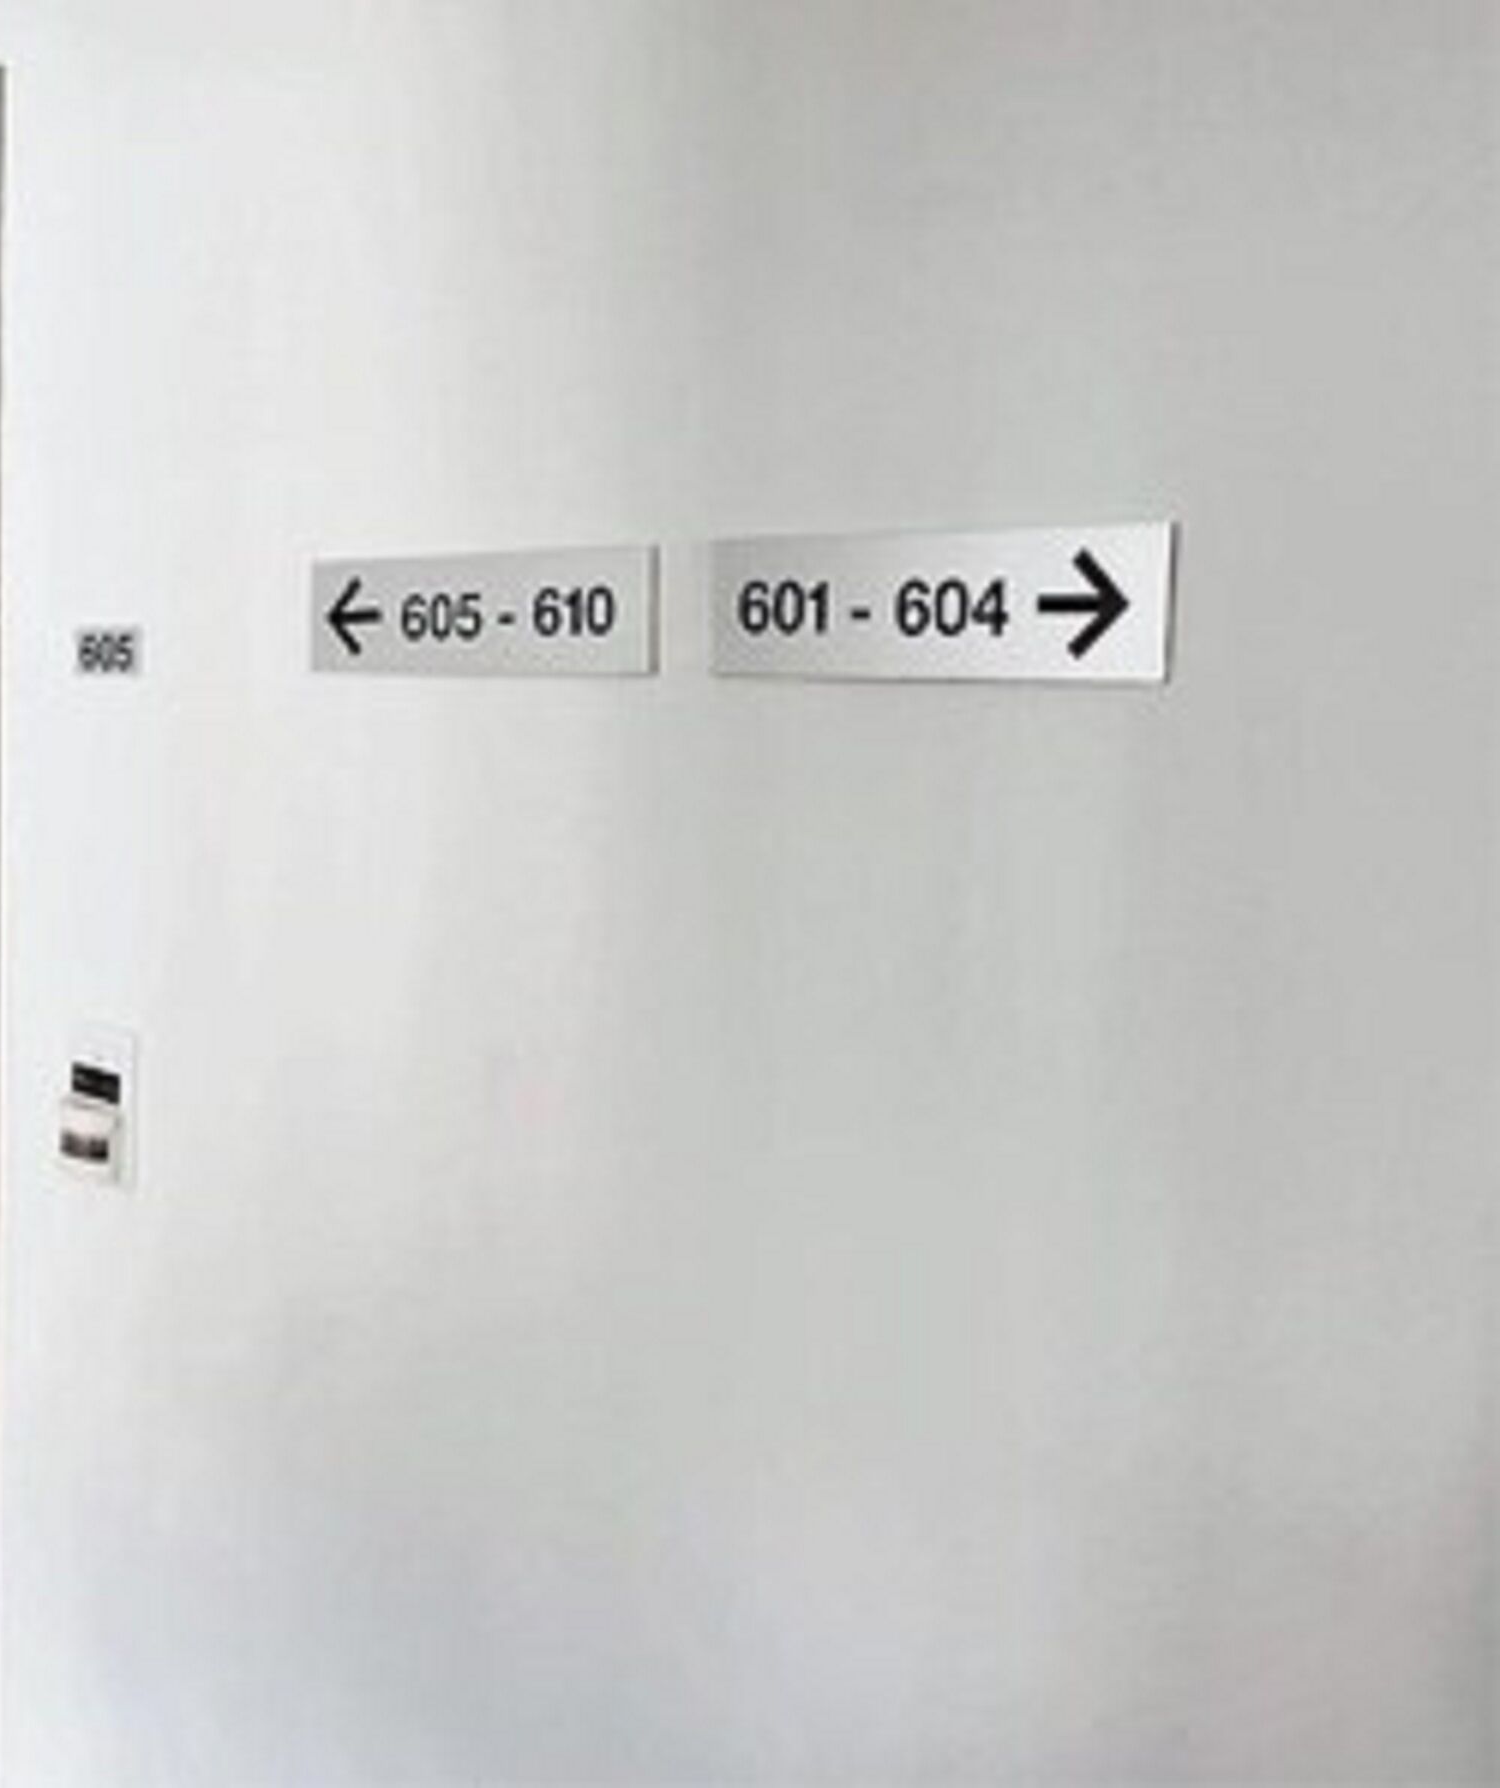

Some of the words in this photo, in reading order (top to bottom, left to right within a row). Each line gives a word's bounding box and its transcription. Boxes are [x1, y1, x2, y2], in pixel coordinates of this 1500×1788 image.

[400, 592, 483, 642] 605
[532, 585, 615, 638] 610
[737, 579, 829, 637] 601
[894, 578, 1009, 638] 604
[81, 633, 133, 672] 605
